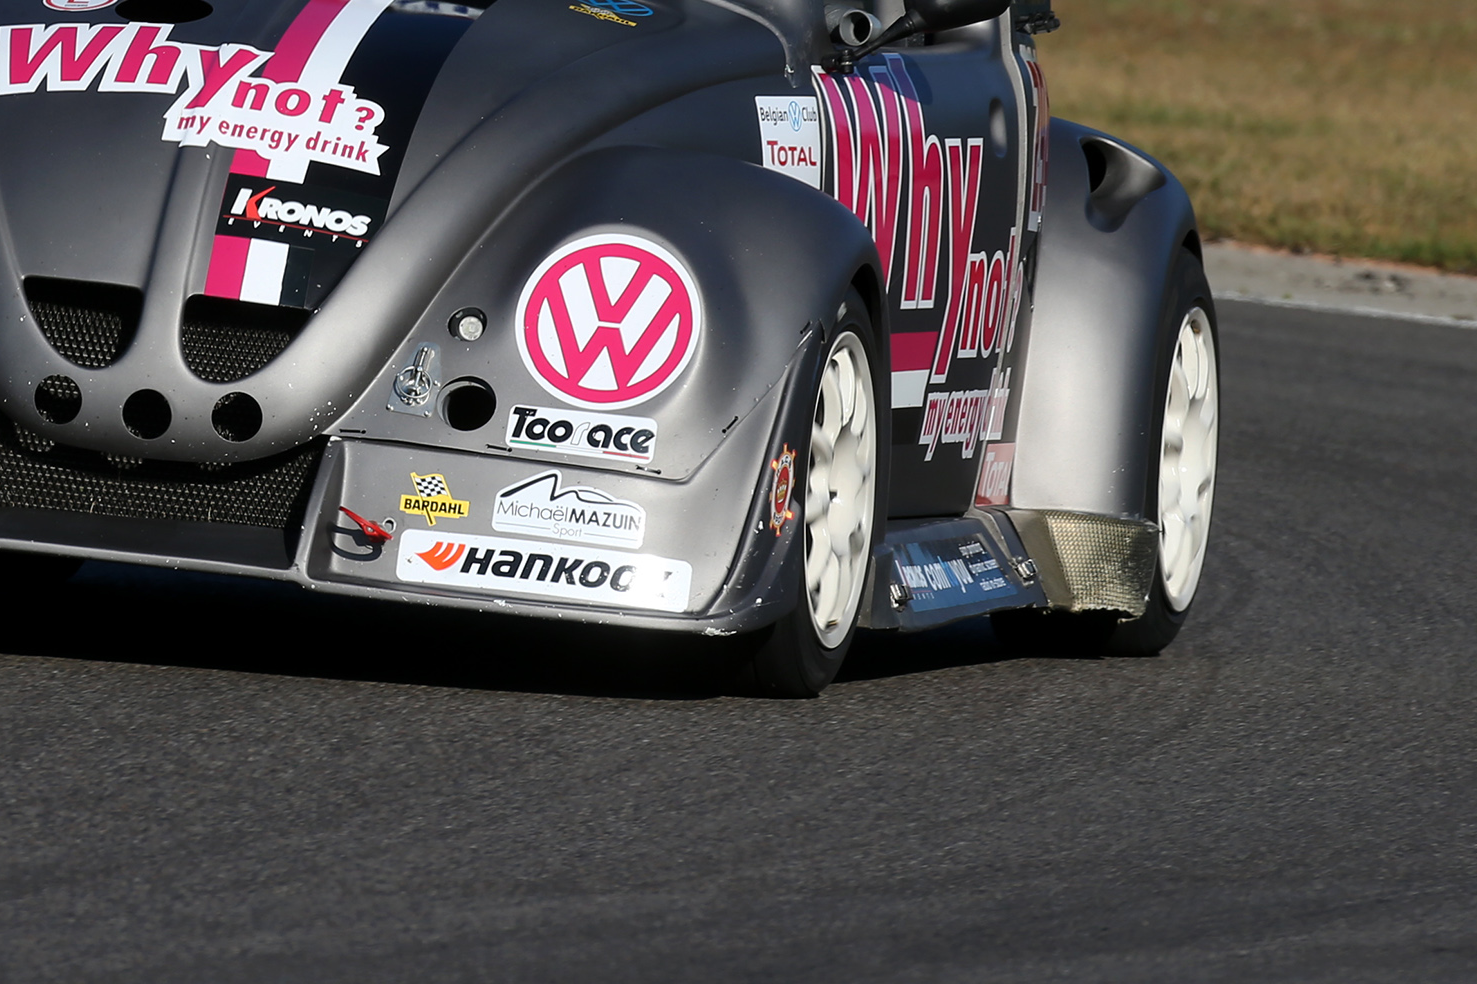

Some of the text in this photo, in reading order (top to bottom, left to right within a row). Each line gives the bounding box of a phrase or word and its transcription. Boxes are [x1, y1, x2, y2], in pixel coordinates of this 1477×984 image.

[9, 25, 260, 109] Why
[759, 107, 789, 126] Belgian
[802, 107, 817, 123] Club
[177, 115, 371, 163] my energy drink
[766, 140, 817, 167] TOTAL
[230, 186, 372, 236] KRONOS
[404, 497, 464, 516] BARDAHL
[551, 524, 583, 538] Sport
